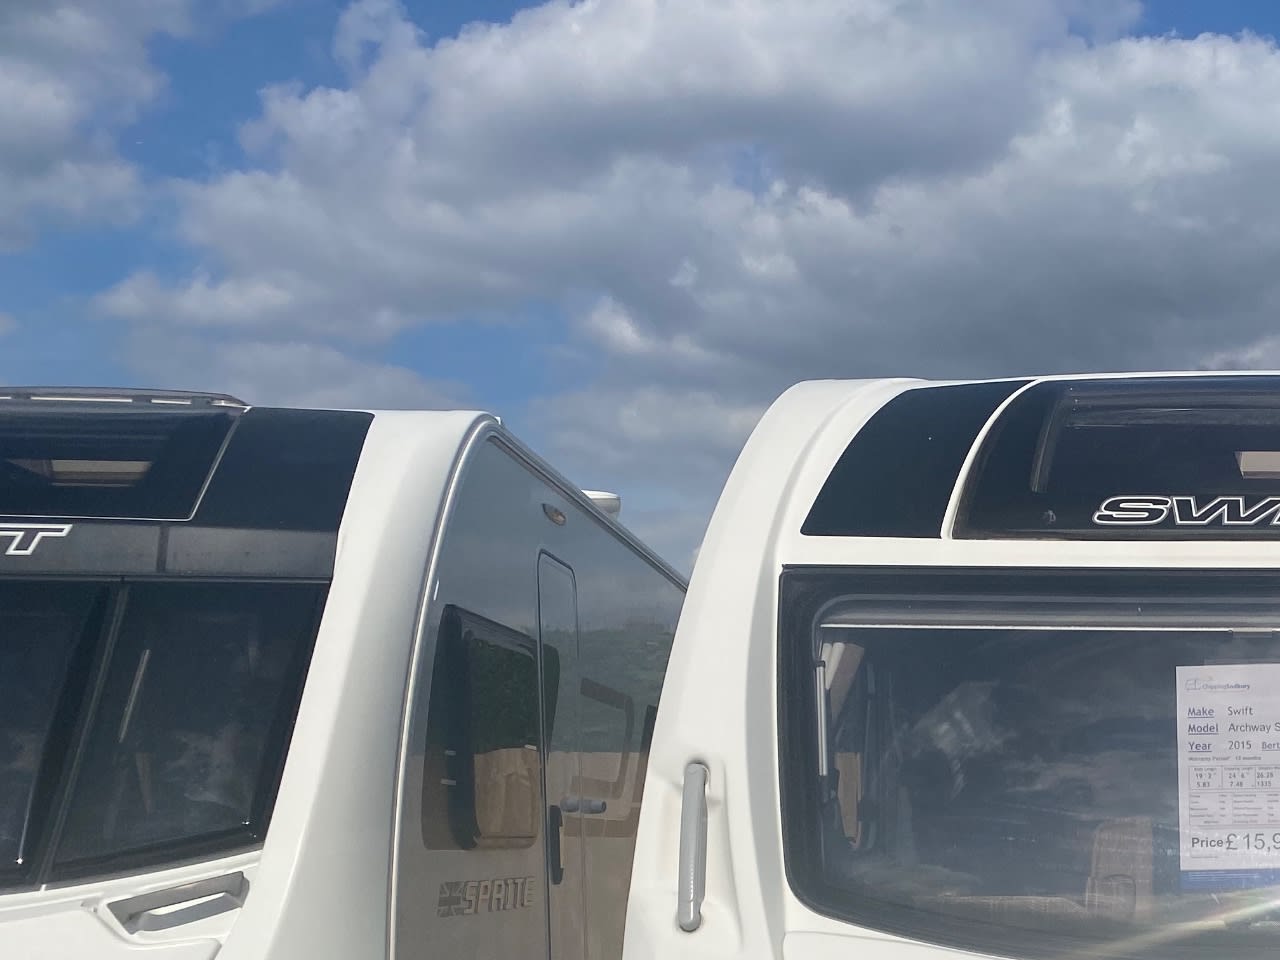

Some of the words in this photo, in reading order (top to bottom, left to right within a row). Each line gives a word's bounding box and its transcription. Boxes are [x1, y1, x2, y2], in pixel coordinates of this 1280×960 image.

[1187, 706, 1215, 718] Make
[1227, 706, 1254, 716] Swift
[1188, 723, 1219, 735] Model
[1228, 723, 1271, 734] Archway
[1188, 742, 1213, 752] Year
[1228, 740, 1252, 750] 2015
[1191, 837, 1224, 848] Price
